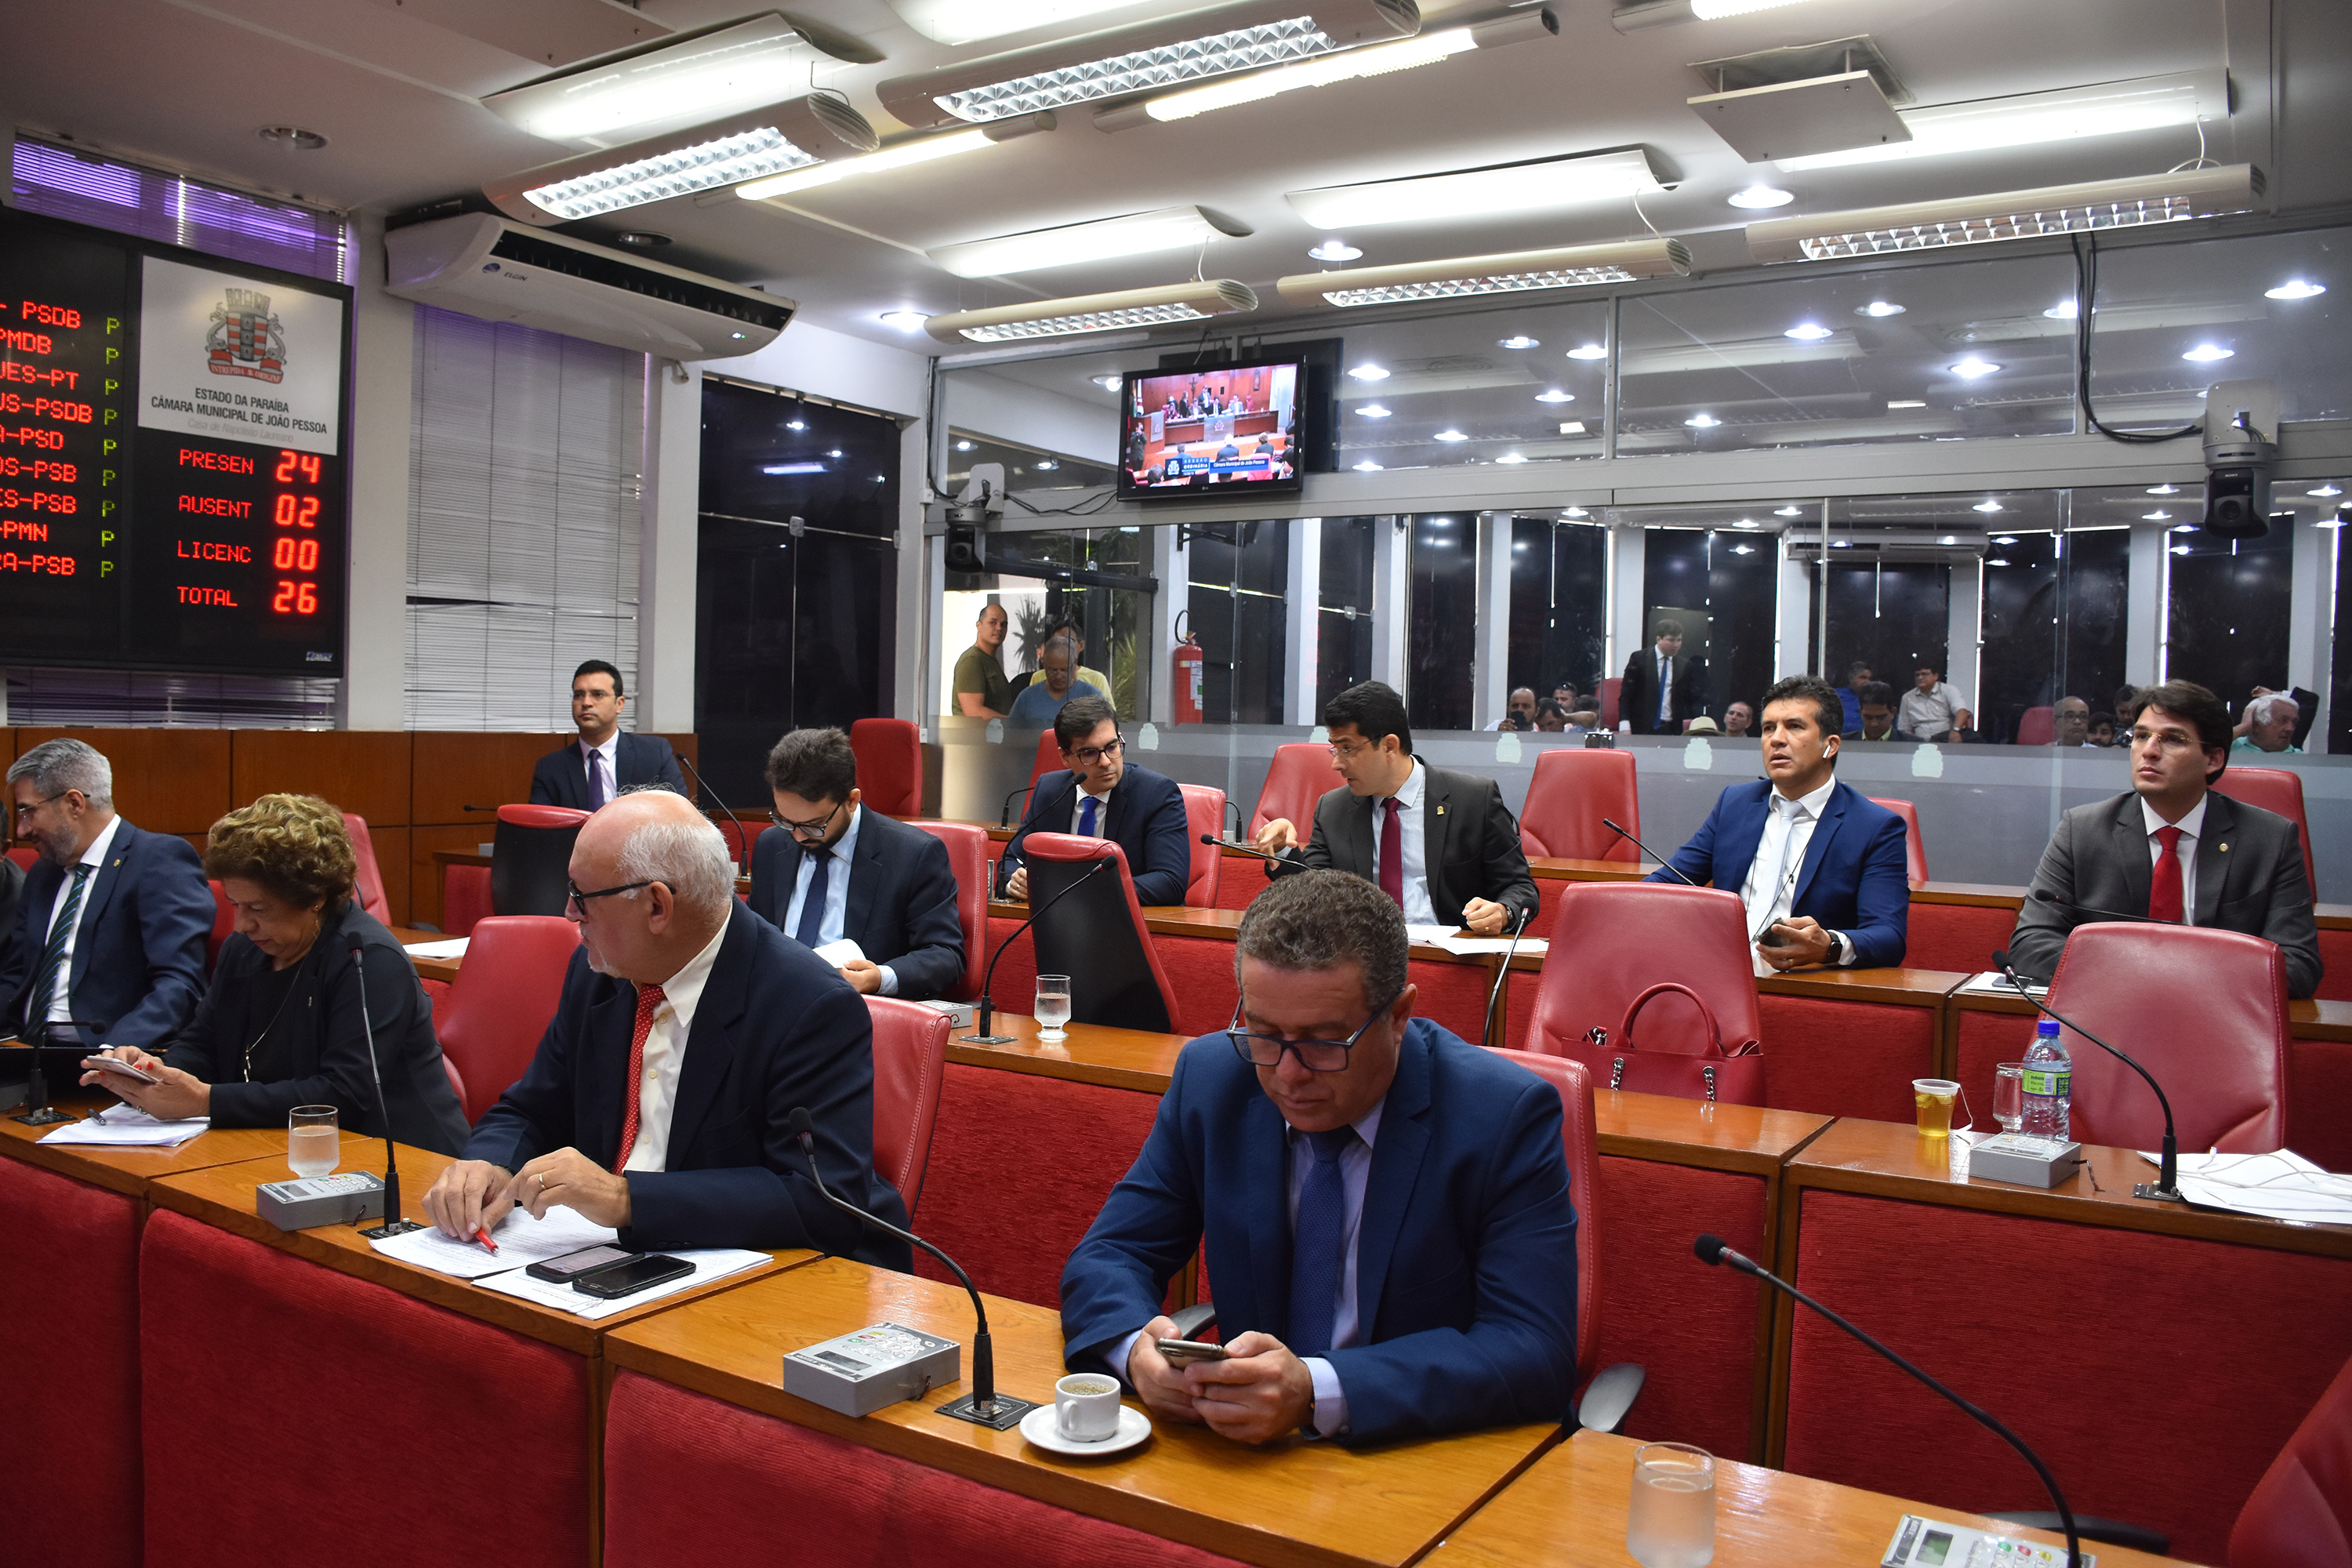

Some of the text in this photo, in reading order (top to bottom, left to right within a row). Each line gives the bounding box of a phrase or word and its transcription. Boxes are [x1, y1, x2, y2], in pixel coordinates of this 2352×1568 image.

[504, 272, 528, 281] ELGIN
[22, 301, 81, 328] PSDB
[107, 318, 120, 334] P
[106, 347, 119, 365] P
[105, 379, 118, 395] P
[195, 388, 289, 413] ESTADO DA PARAÍBA
[104, 408, 118, 425] P
[151, 394, 327, 434] CÂMARA MUNICIPAL DE JOÃO PESSOA
[103, 439, 117, 456] P
[103, 470, 116, 486] P
[180, 449, 321, 484] PRESEN 24
[0, 488, 115, 517] S-PSB P
[179, 493, 320, 528] AUSENT 02
[102, 531, 114, 546] P
[0, 552, 114, 577] A-PSB P
[178, 536, 319, 572] LICENC 00
[177, 579, 318, 615] TOTAL 26
